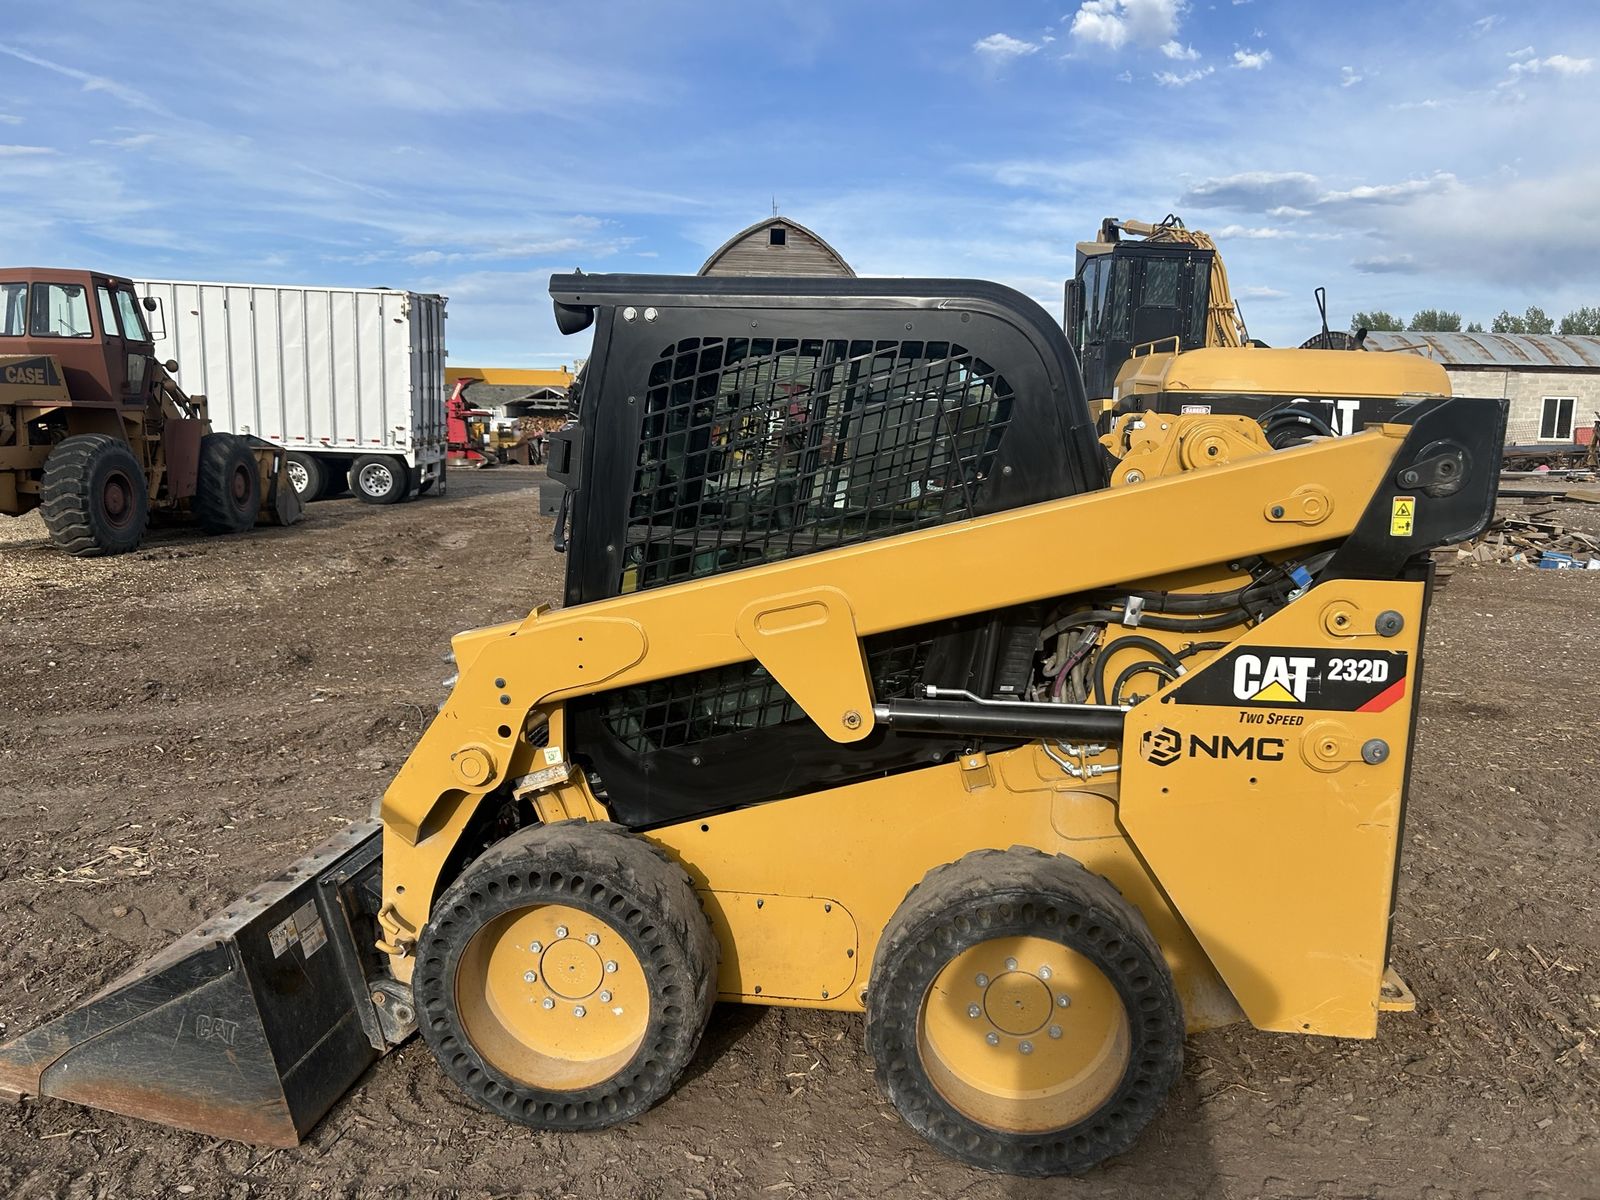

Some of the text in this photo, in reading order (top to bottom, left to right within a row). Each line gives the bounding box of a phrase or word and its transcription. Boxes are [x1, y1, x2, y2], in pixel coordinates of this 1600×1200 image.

[5, 366, 45, 385] CASE
[1233, 654, 1389, 703] CAT 232D
[1189, 734, 1284, 761] NMC
[196, 1013, 240, 1046] CAT
